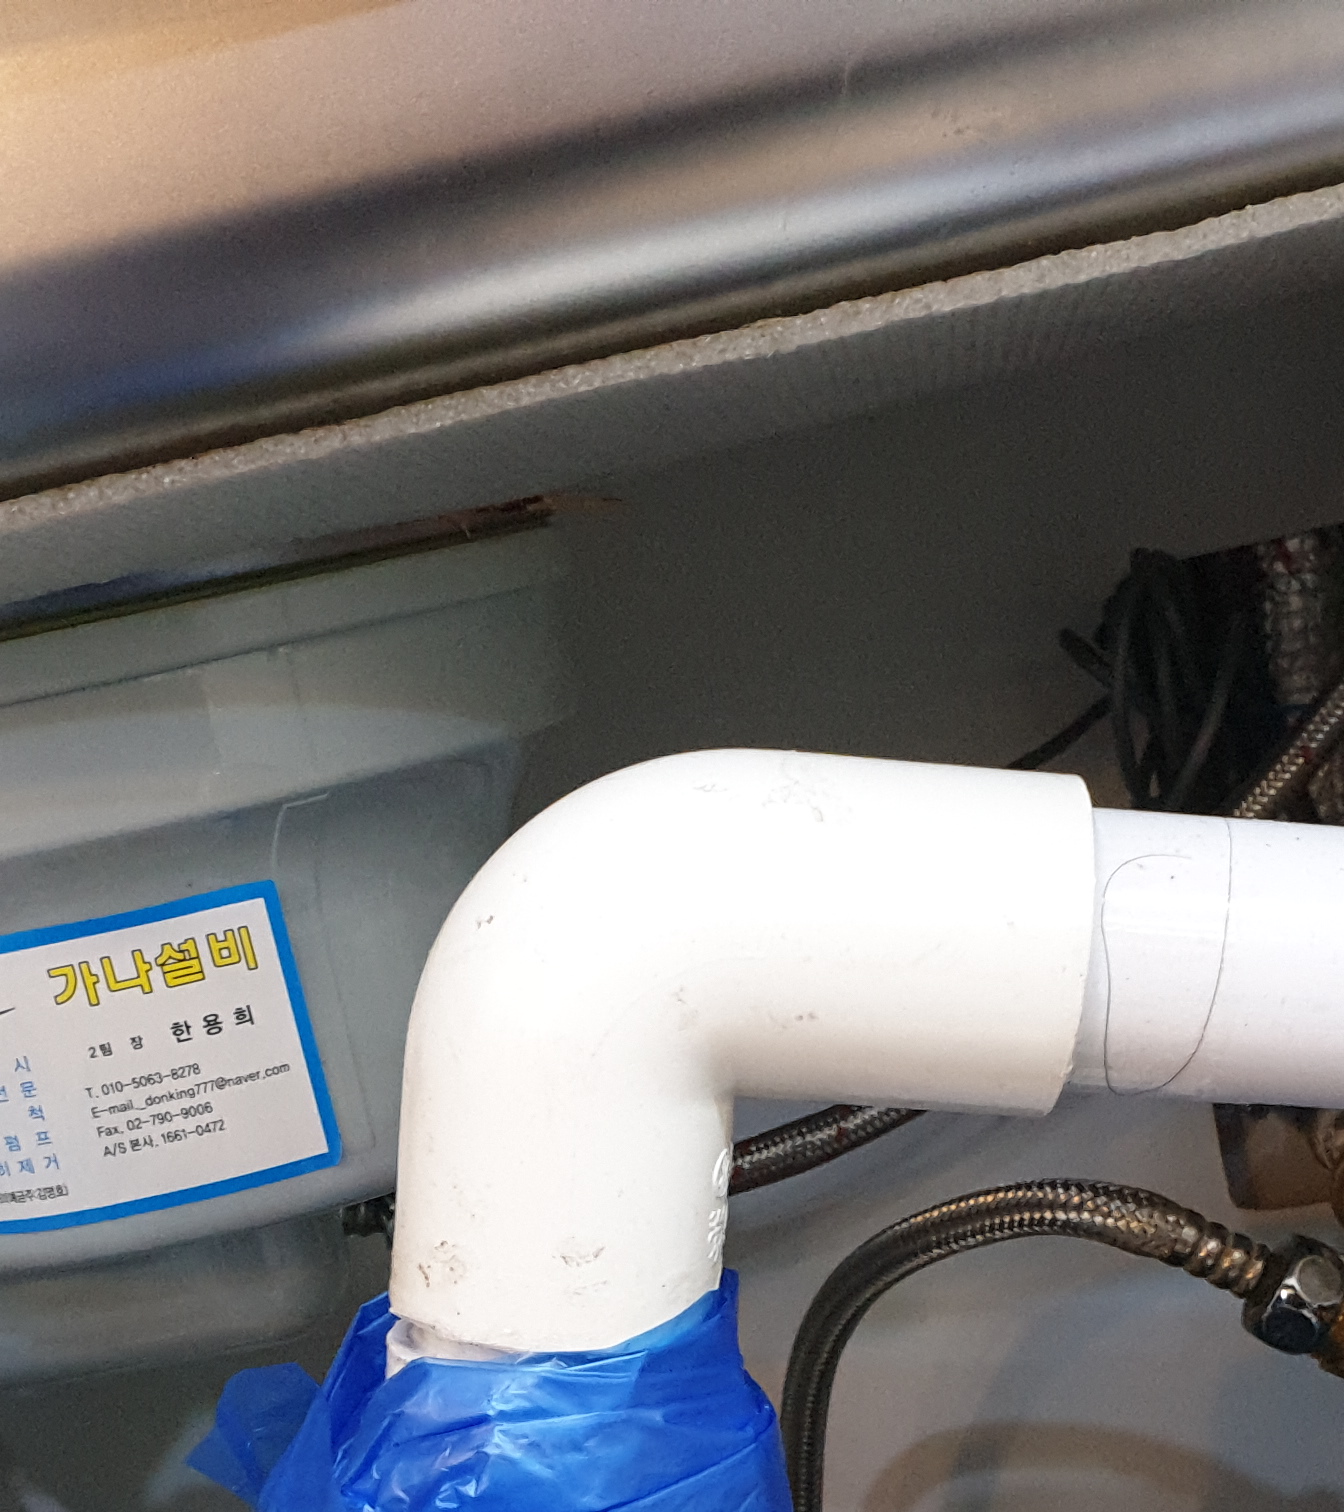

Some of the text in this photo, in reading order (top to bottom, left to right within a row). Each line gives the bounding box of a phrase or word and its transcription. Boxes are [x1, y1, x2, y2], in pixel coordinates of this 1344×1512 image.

[46, 925, 259, 1008] 가나설비
[101, 1063, 201, 1096] 010-5063-8278
[96, 1101, 213, 1139] Fax. 02-790-9006
[103, 1142, 128, 1158] A/S
[160, 1119, 226, 1144] 1661-0472
